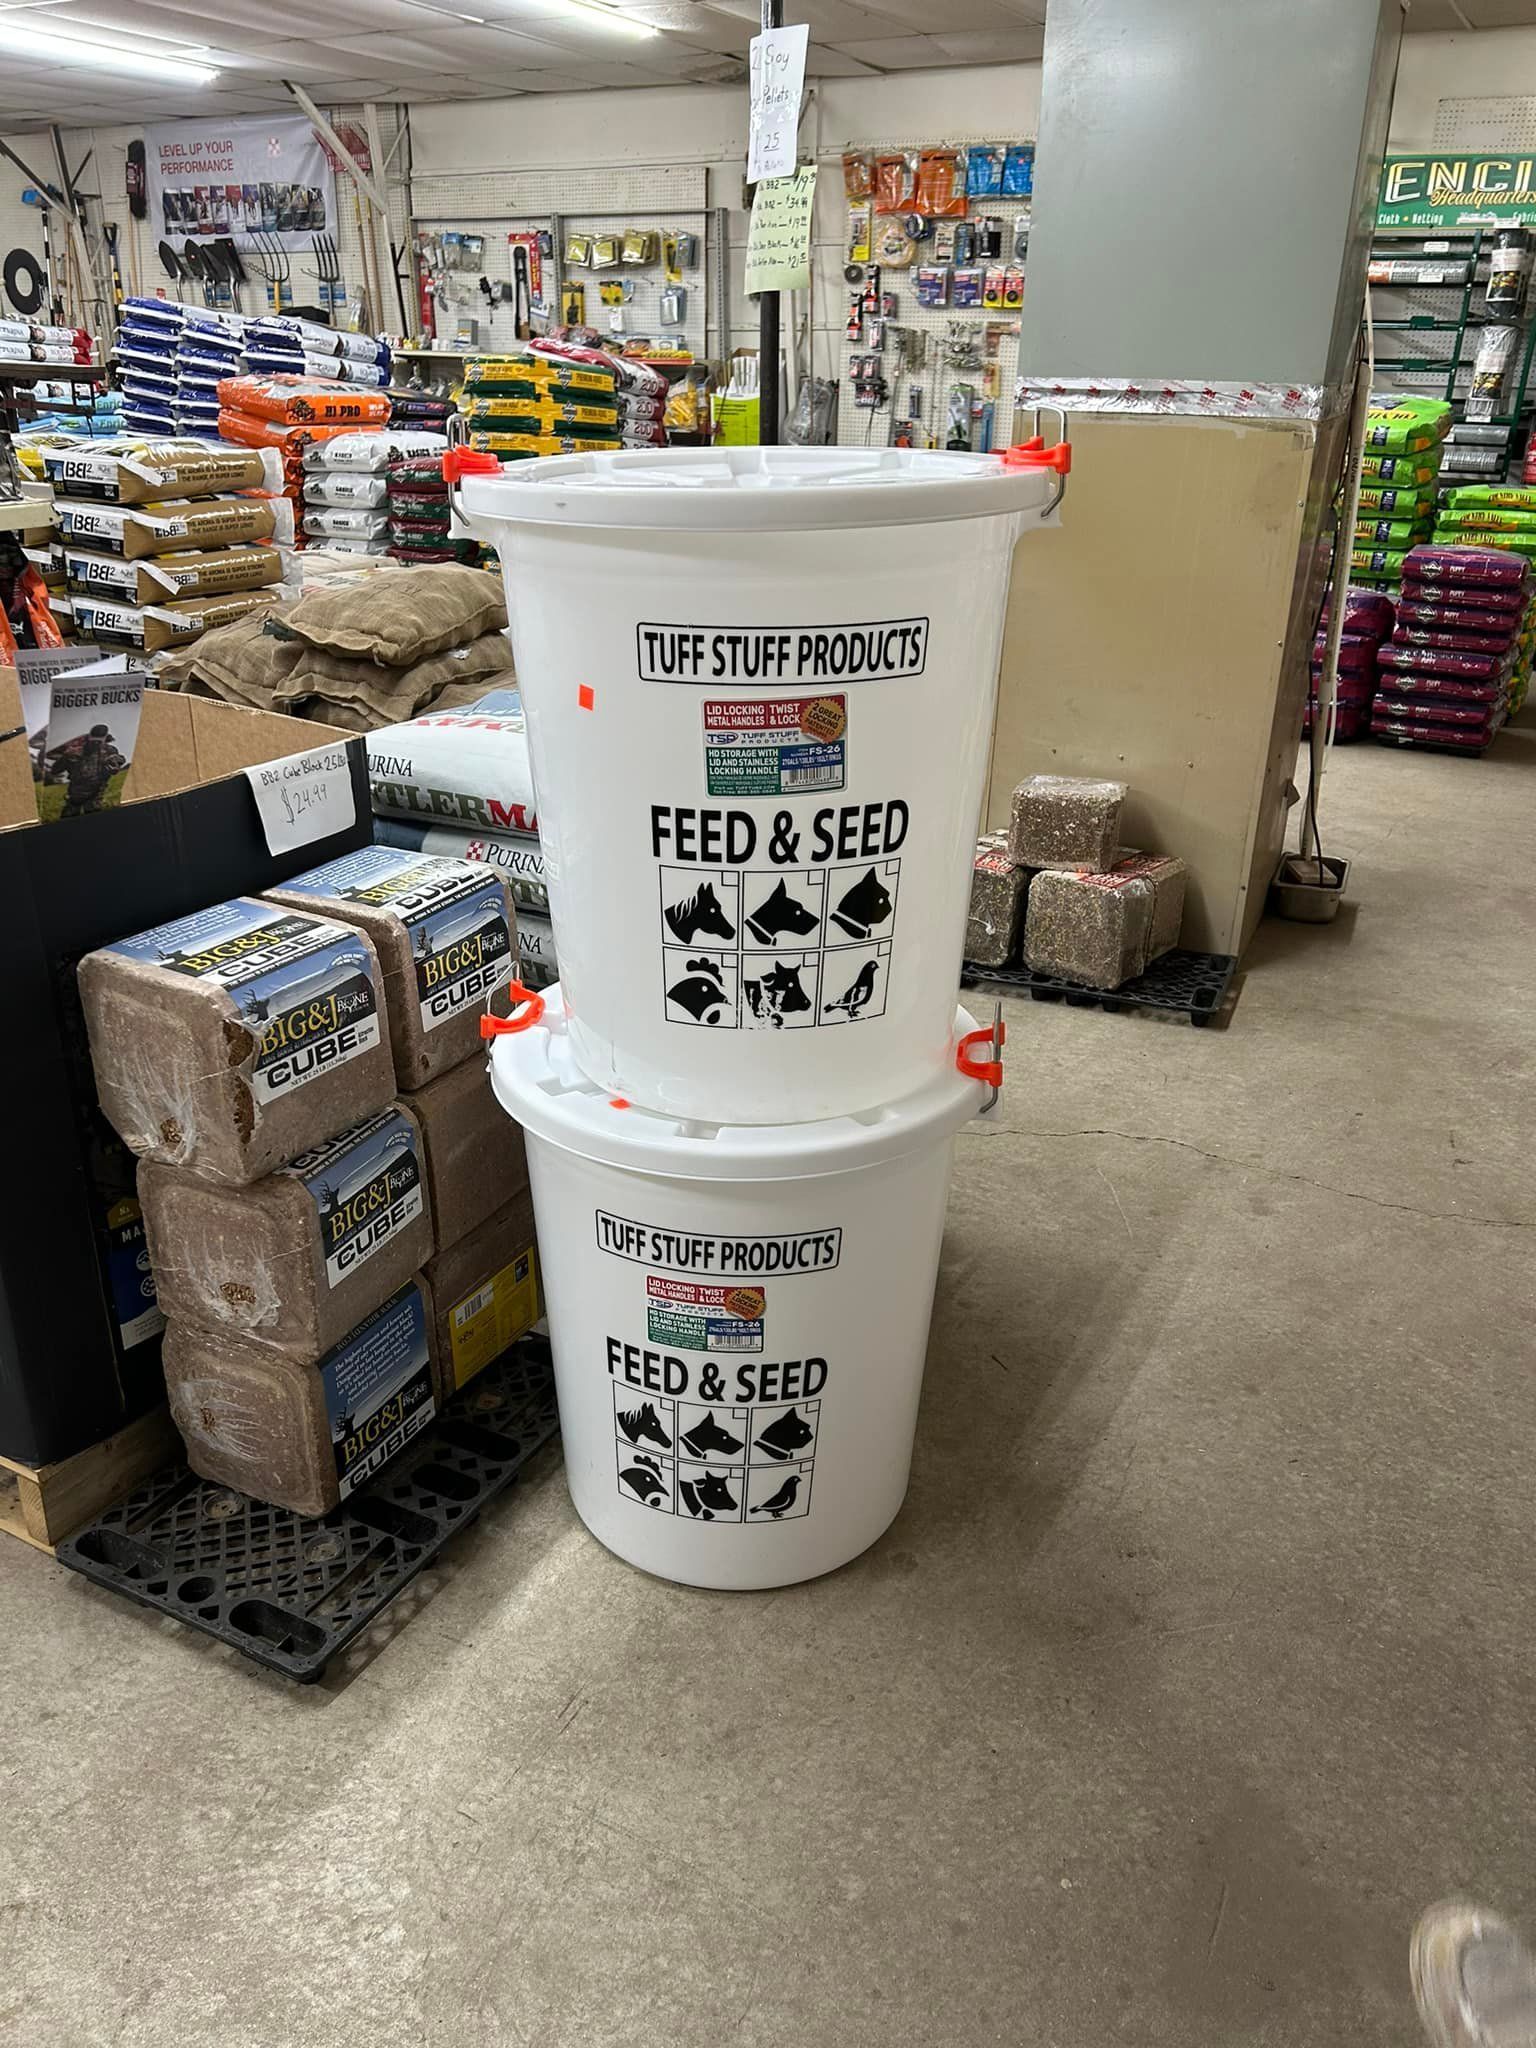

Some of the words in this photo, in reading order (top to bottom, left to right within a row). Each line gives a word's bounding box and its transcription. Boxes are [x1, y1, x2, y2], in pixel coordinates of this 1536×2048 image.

[765, 43, 789, 72] Soy
[763, 84, 789, 110] Pellets
[159, 143, 187, 157] LEVEL
[189, 142, 202, 155] UP
[204, 140, 233, 154] YOUR
[160, 158, 234, 175] PERFORMANCE
[1384, 160, 1533, 203] ENCI
[1378, 213, 1400, 225] Cloth
[1412, 213, 1444, 226] Netting
[641, 379, 657, 392] 200
[325, 406, 337, 416] HI
[340, 405, 361, 417] PRO
[634, 424, 651, 435] 200
[644, 631, 705, 676] TUFF
[712, 633, 791, 677] STUFF
[798, 626, 921, 677] PRODUCTS
[53, 693, 98, 709] BIGGER
[101, 689, 141, 705] BUCKS
[707, 705, 722, 715] LID
[723, 704, 765, 715] LOCKING
[769, 703, 800, 714] TWIST
[707, 716, 731, 726] METAL
[731, 716, 765, 726] HANDLES
[770, 716, 777, 725] &
[778, 714, 800, 724] LOCK
[808, 711, 839, 729] LOCKING
[813, 702, 819, 710] 2
[819, 706, 842, 721] GREAT
[706, 732, 736, 743] TSP
[768, 730, 800, 738] STUFF
[709, 749, 720, 757] HD
[720, 749, 756, 758] STORAGE
[756, 748, 778, 757] WITH
[810, 745, 841, 755] FS-26
[283, 766, 301, 780] Cube
[300, 758, 323, 774] Block
[367, 754, 413, 777] URINA
[709, 758, 723, 766] LID
[724, 758, 738, 766] AND
[739, 757, 778, 766] STAINLESS
[709, 766, 744, 775] LOCKING
[746, 766, 779, 775] HANDLE
[281, 784, 328, 826] $24.99
[651, 804, 757, 864] FEED
[768, 810, 800, 864] &
[811, 799, 909, 861] SEED
[178, 930, 282, 971] BIG&J
[218, 935, 322, 977] CUBE
[423, 933, 484, 987] BIG&J
[431, 965, 497, 1017] CUBE
[261, 993, 338, 1056] BIG&J
[267, 1026, 358, 1089] CUBE
[329, 1172, 392, 1242] BIG&J
[337, 1199, 406, 1271] CUBE
[601, 1216, 646, 1256] TUFF
[651, 1233, 715, 1269] STUFF
[720, 1234, 834, 1271] PRODUCTS
[648, 1278, 661, 1288] LID
[661, 1280, 695, 1293] LOCKING
[699, 1287, 725, 1297] TWIST
[649, 1286, 667, 1297] METAL
[667, 1291, 695, 1301] HANDLES
[706, 1296, 725, 1304] LOCK
[658, 1311, 687, 1322] STORAGE
[688, 1316, 706, 1324] WITH
[659, 1317, 672, 1325] AND
[672, 1319, 706, 1330] STAINLESS
[650, 1321, 678, 1332] LOCKING
[678, 1326, 705, 1336] HANDLE
[606, 1336, 689, 1396] FEED
[698, 1362, 726, 1402] &
[735, 1357, 828, 1402] SEED
[342, 1391, 404, 1465] BIG&J
[350, 1410, 420, 1490] CUBE
